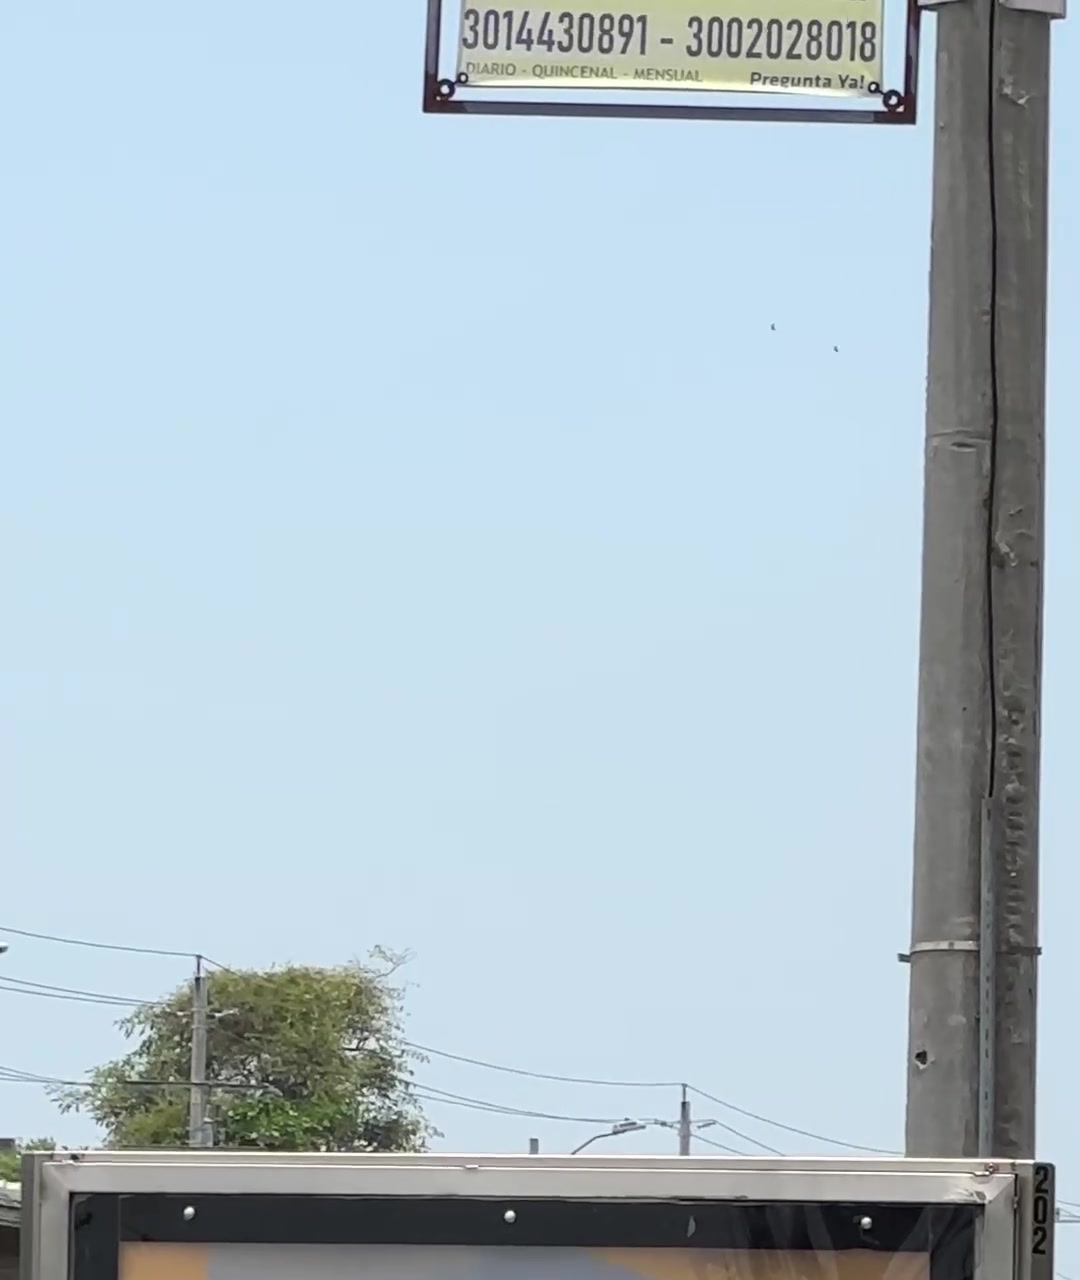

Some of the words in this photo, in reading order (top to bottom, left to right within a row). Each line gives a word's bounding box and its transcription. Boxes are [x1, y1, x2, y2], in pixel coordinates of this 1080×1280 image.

[462, 8, 648, 56] 3014430891
[660, 37, 674, 45] -
[686, 15, 876, 62] 3002028018
[466, 62, 516, 77] DIARIO
[532, 63, 618, 80] QUINCENAL
[633, 68, 702, 82] MENSUAL
[750, 72, 832, 88] Pregunta
[838, 74, 865, 89] Ya!
[1032, 1165, 1049, 1254] 202
